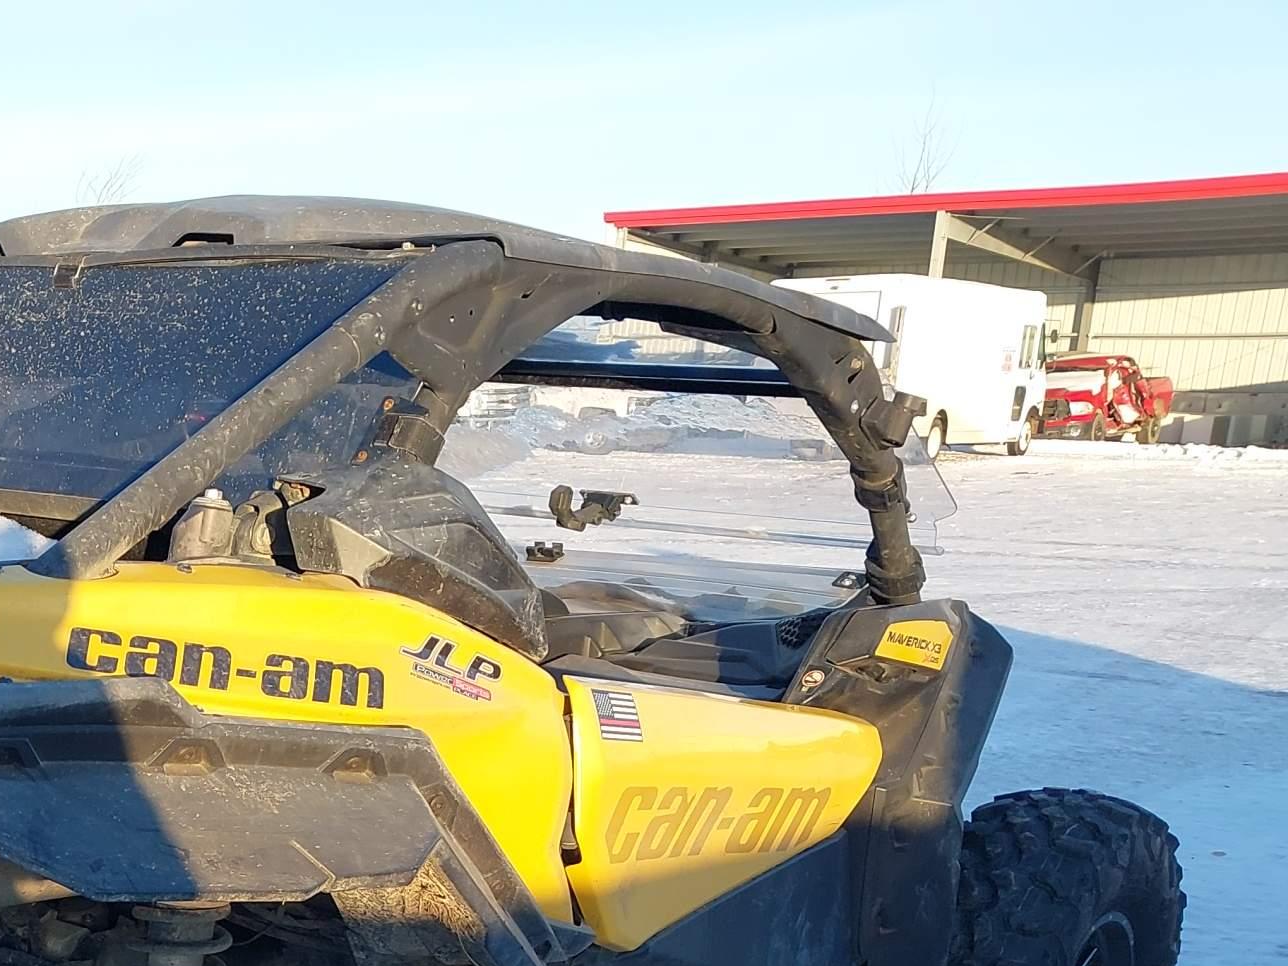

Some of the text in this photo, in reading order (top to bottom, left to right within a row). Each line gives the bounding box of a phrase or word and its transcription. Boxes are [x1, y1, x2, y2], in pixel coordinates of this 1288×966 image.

[400, 634, 502, 681] JLP
[886, 630, 930, 652] MAVERICK
[66, 626, 385, 709] can-am
